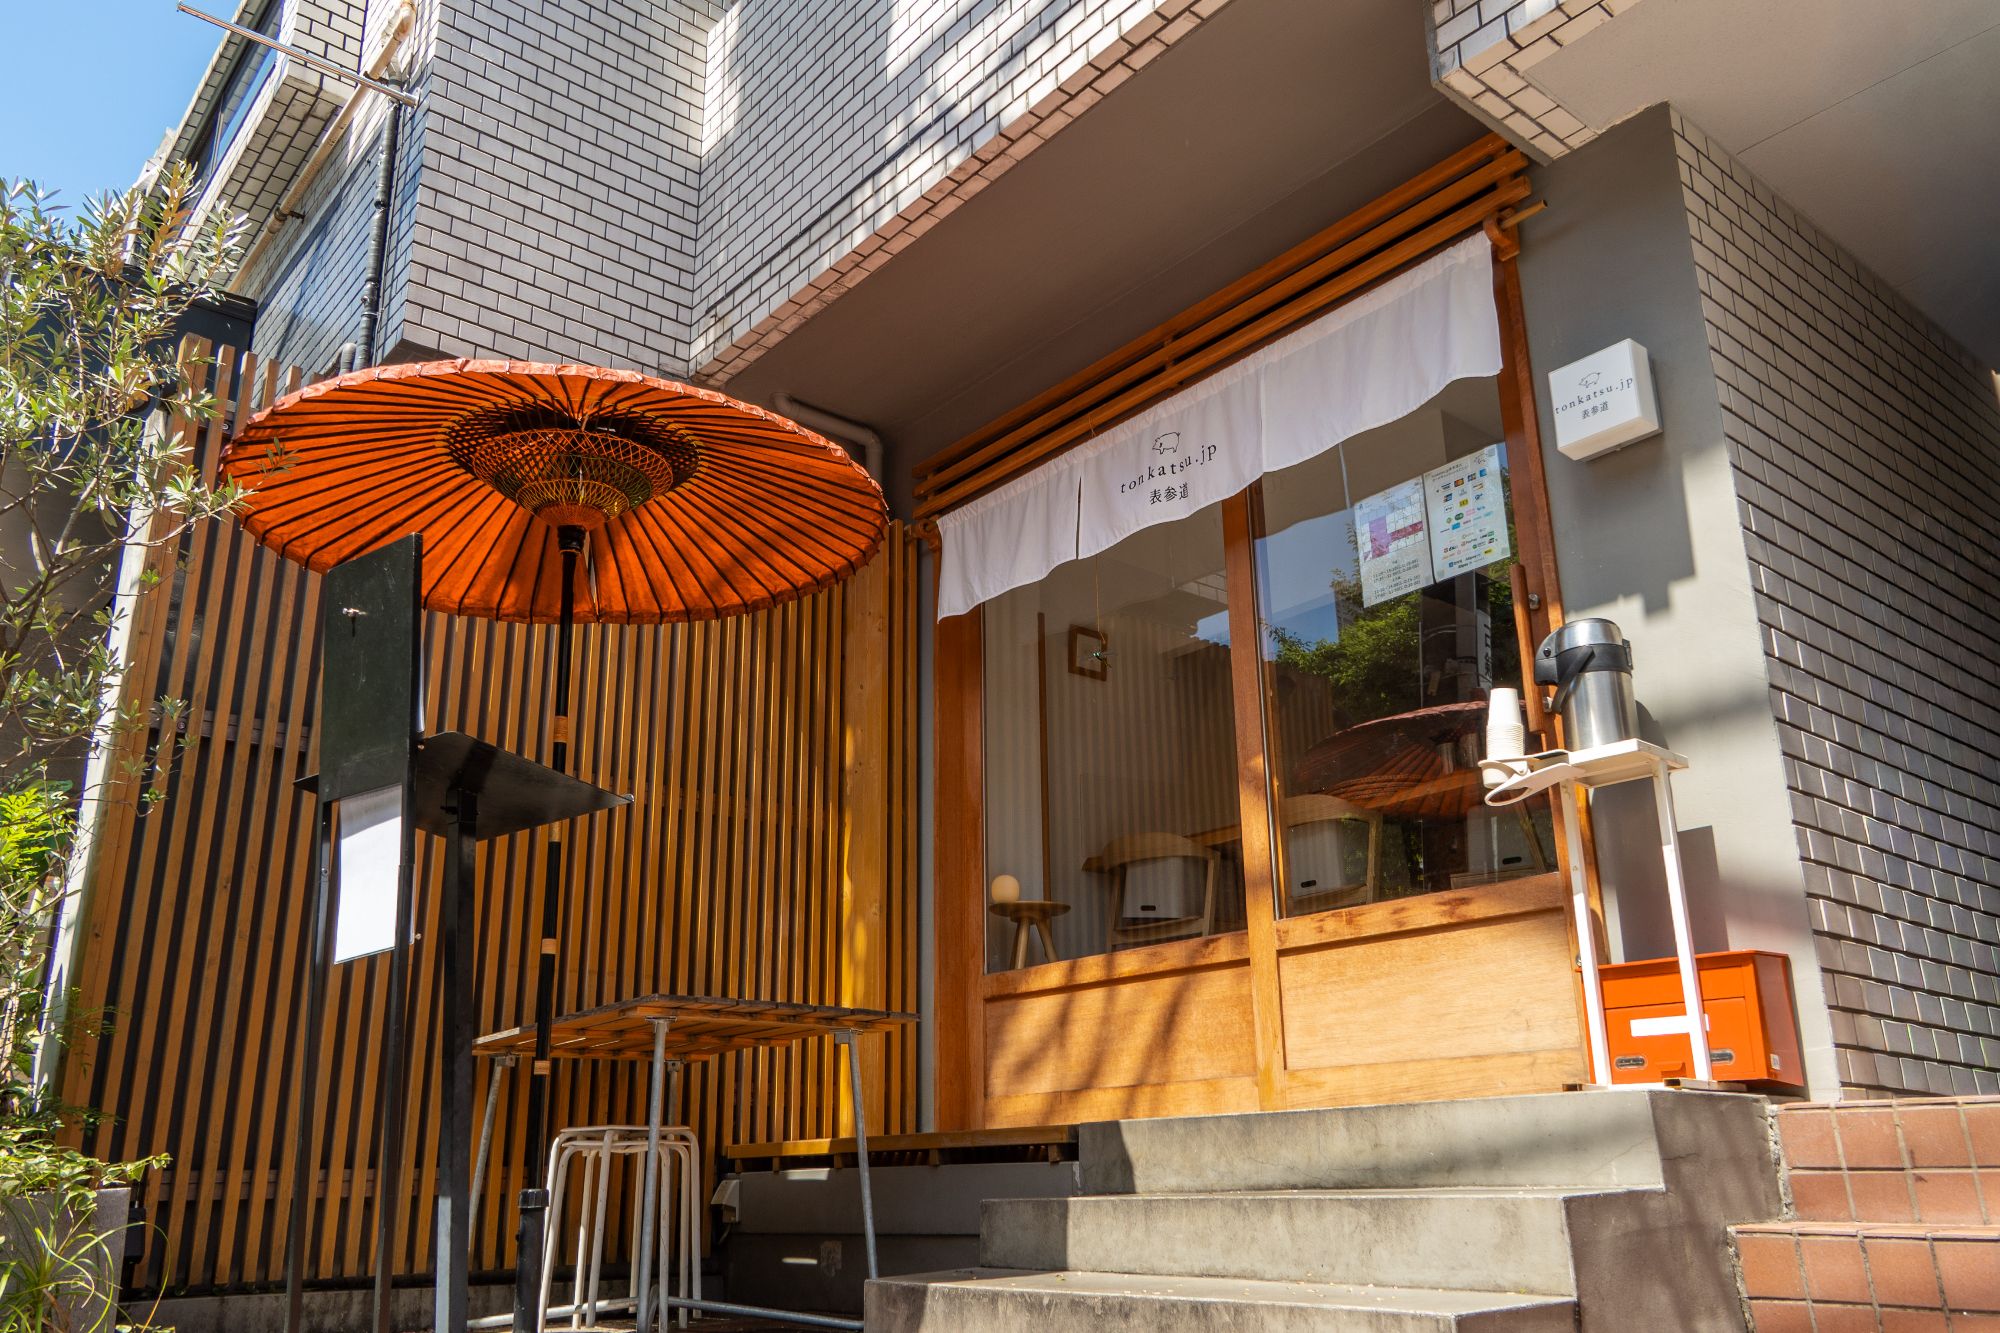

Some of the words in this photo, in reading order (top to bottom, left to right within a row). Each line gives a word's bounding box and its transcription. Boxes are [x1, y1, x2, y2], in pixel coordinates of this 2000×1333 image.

[1555, 377, 1633, 415] tonkatsu.jp
[1581, 400, 1609, 419] 表参道
[1120, 444, 1217, 494] tonkatsu.jp
[1149, 482, 1189, 505] 表参道
